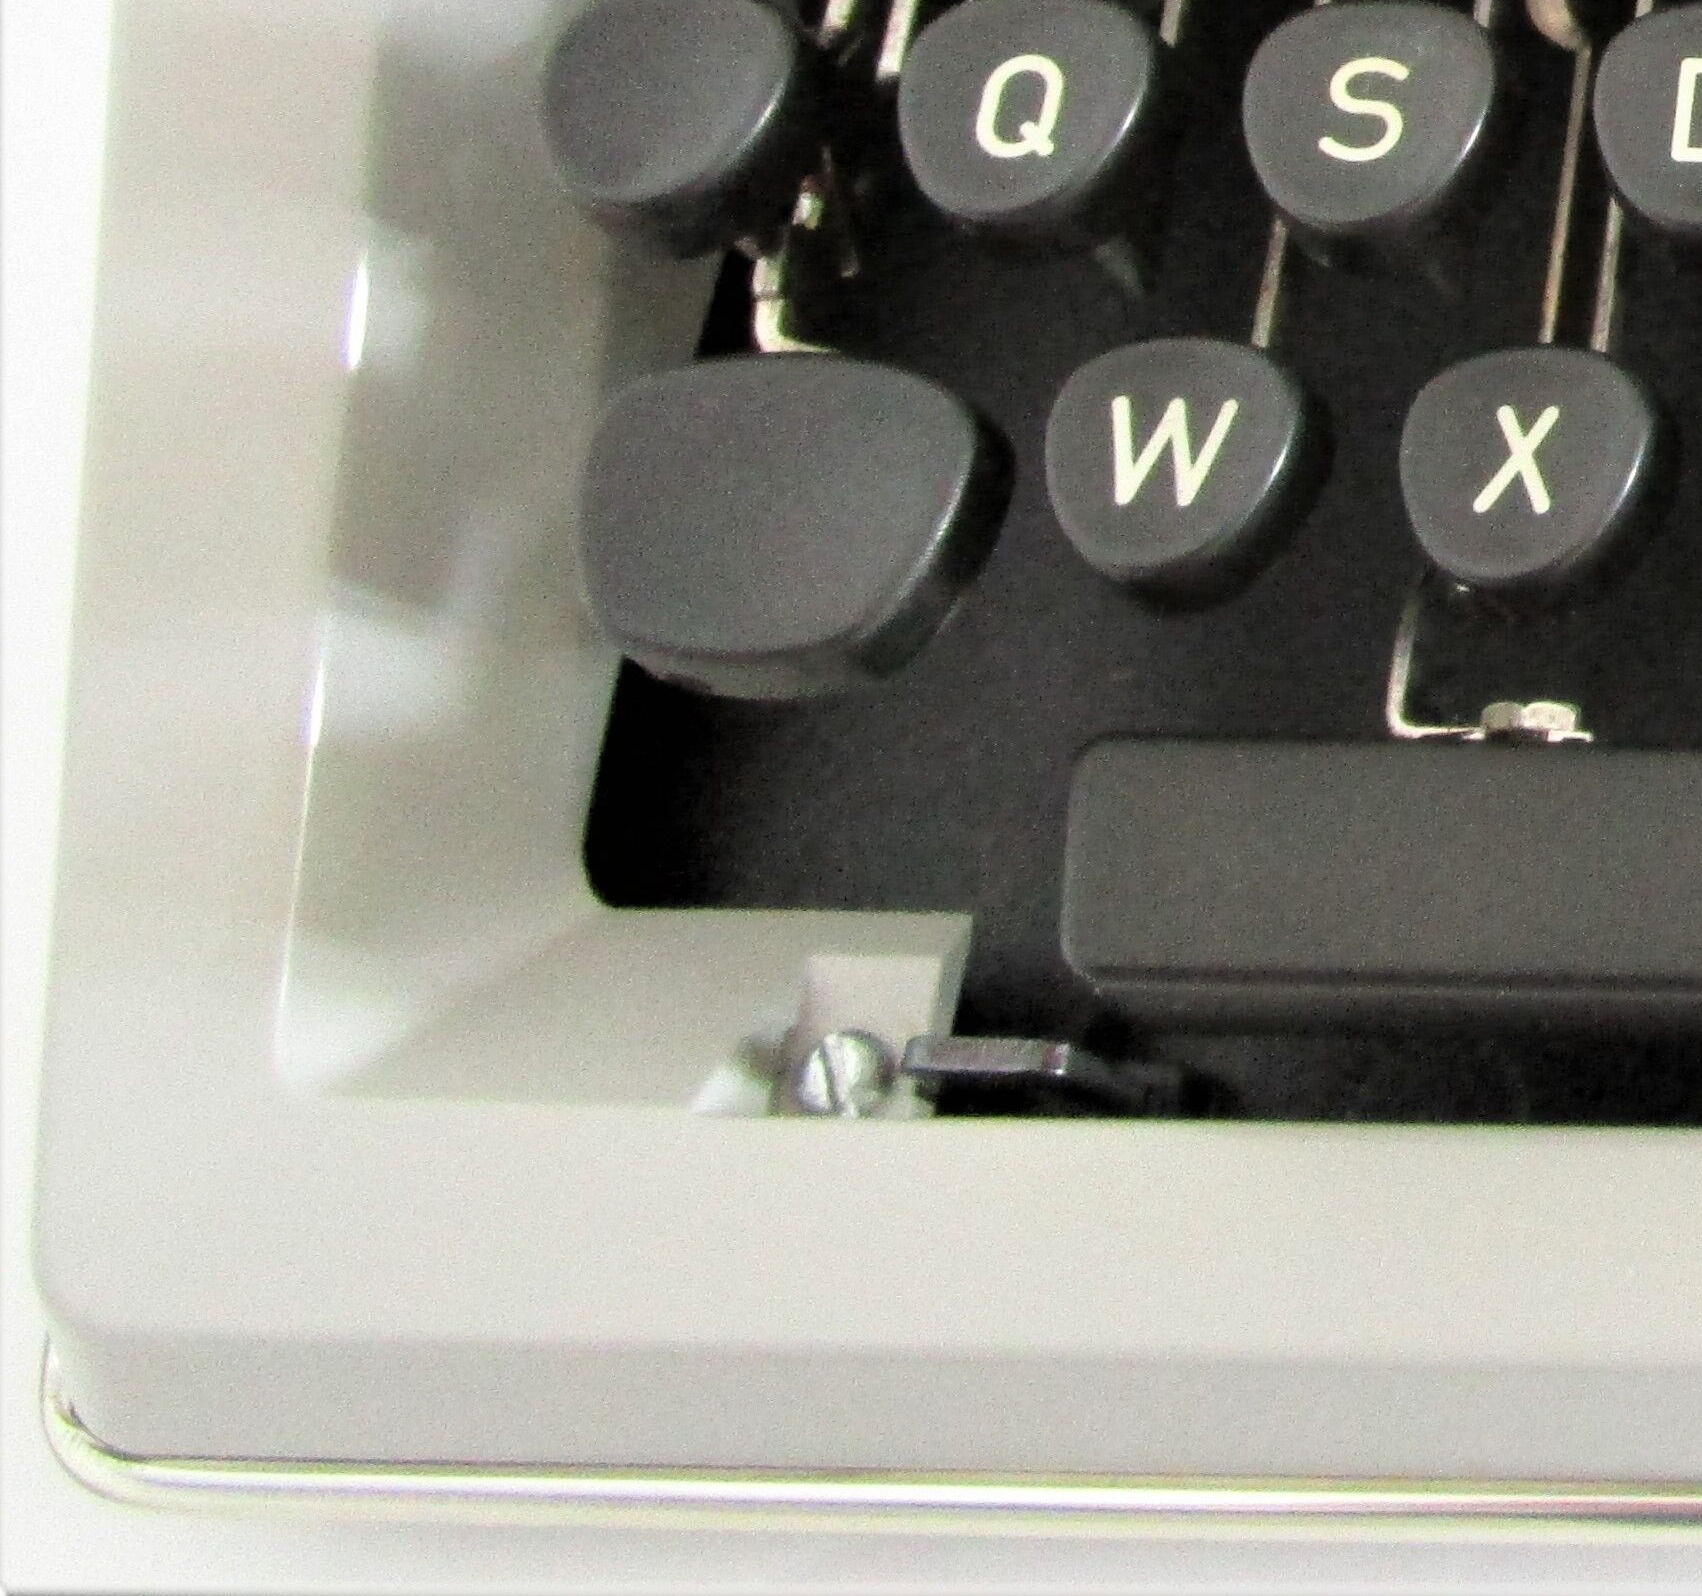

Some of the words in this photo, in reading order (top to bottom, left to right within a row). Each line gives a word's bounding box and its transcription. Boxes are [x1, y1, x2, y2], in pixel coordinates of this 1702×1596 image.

[973, 52, 1068, 161] Q
[1316, 54, 1413, 165] S
[1109, 394, 1241, 510] W
[1471, 403, 1562, 517] X
